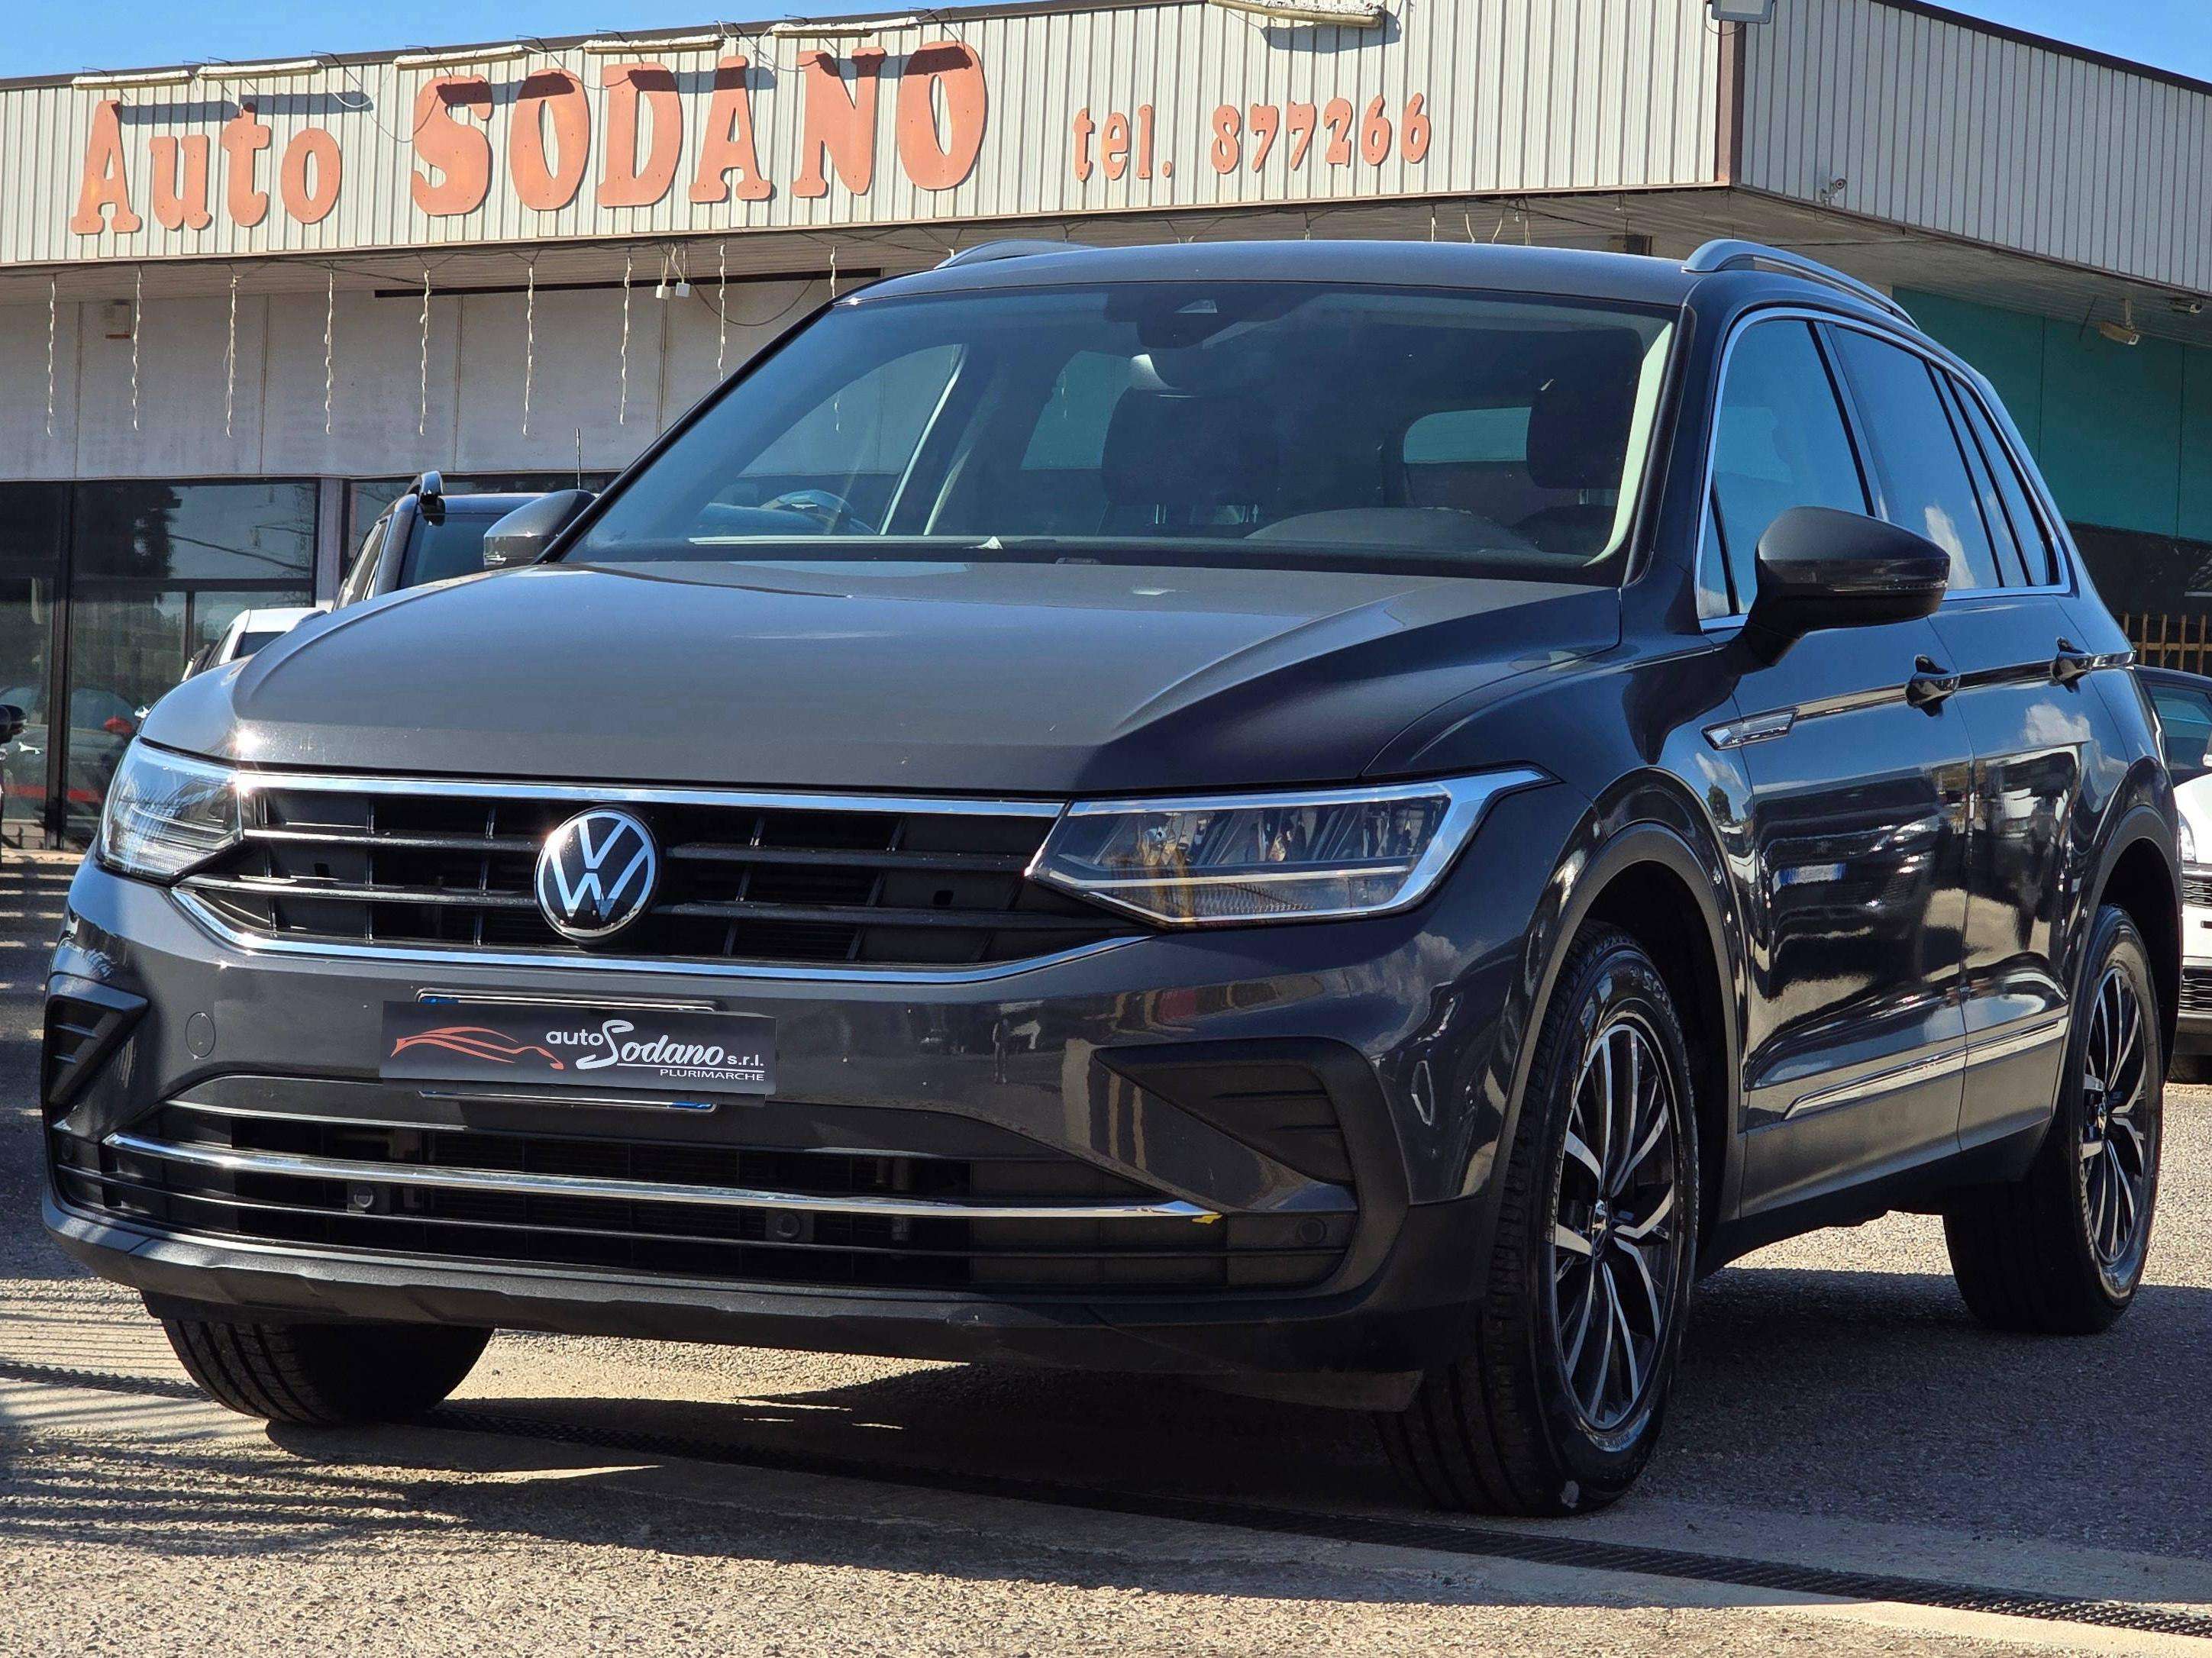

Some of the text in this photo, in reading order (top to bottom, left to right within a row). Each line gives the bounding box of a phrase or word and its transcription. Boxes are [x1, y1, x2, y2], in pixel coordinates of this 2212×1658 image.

[70, 41, 1431, 234] Auto SODANO tel. 877266
[545, 1019, 764, 1070] auto Sodano s.r.l.
[659, 1068, 765, 1082] PLURIMARCHE
